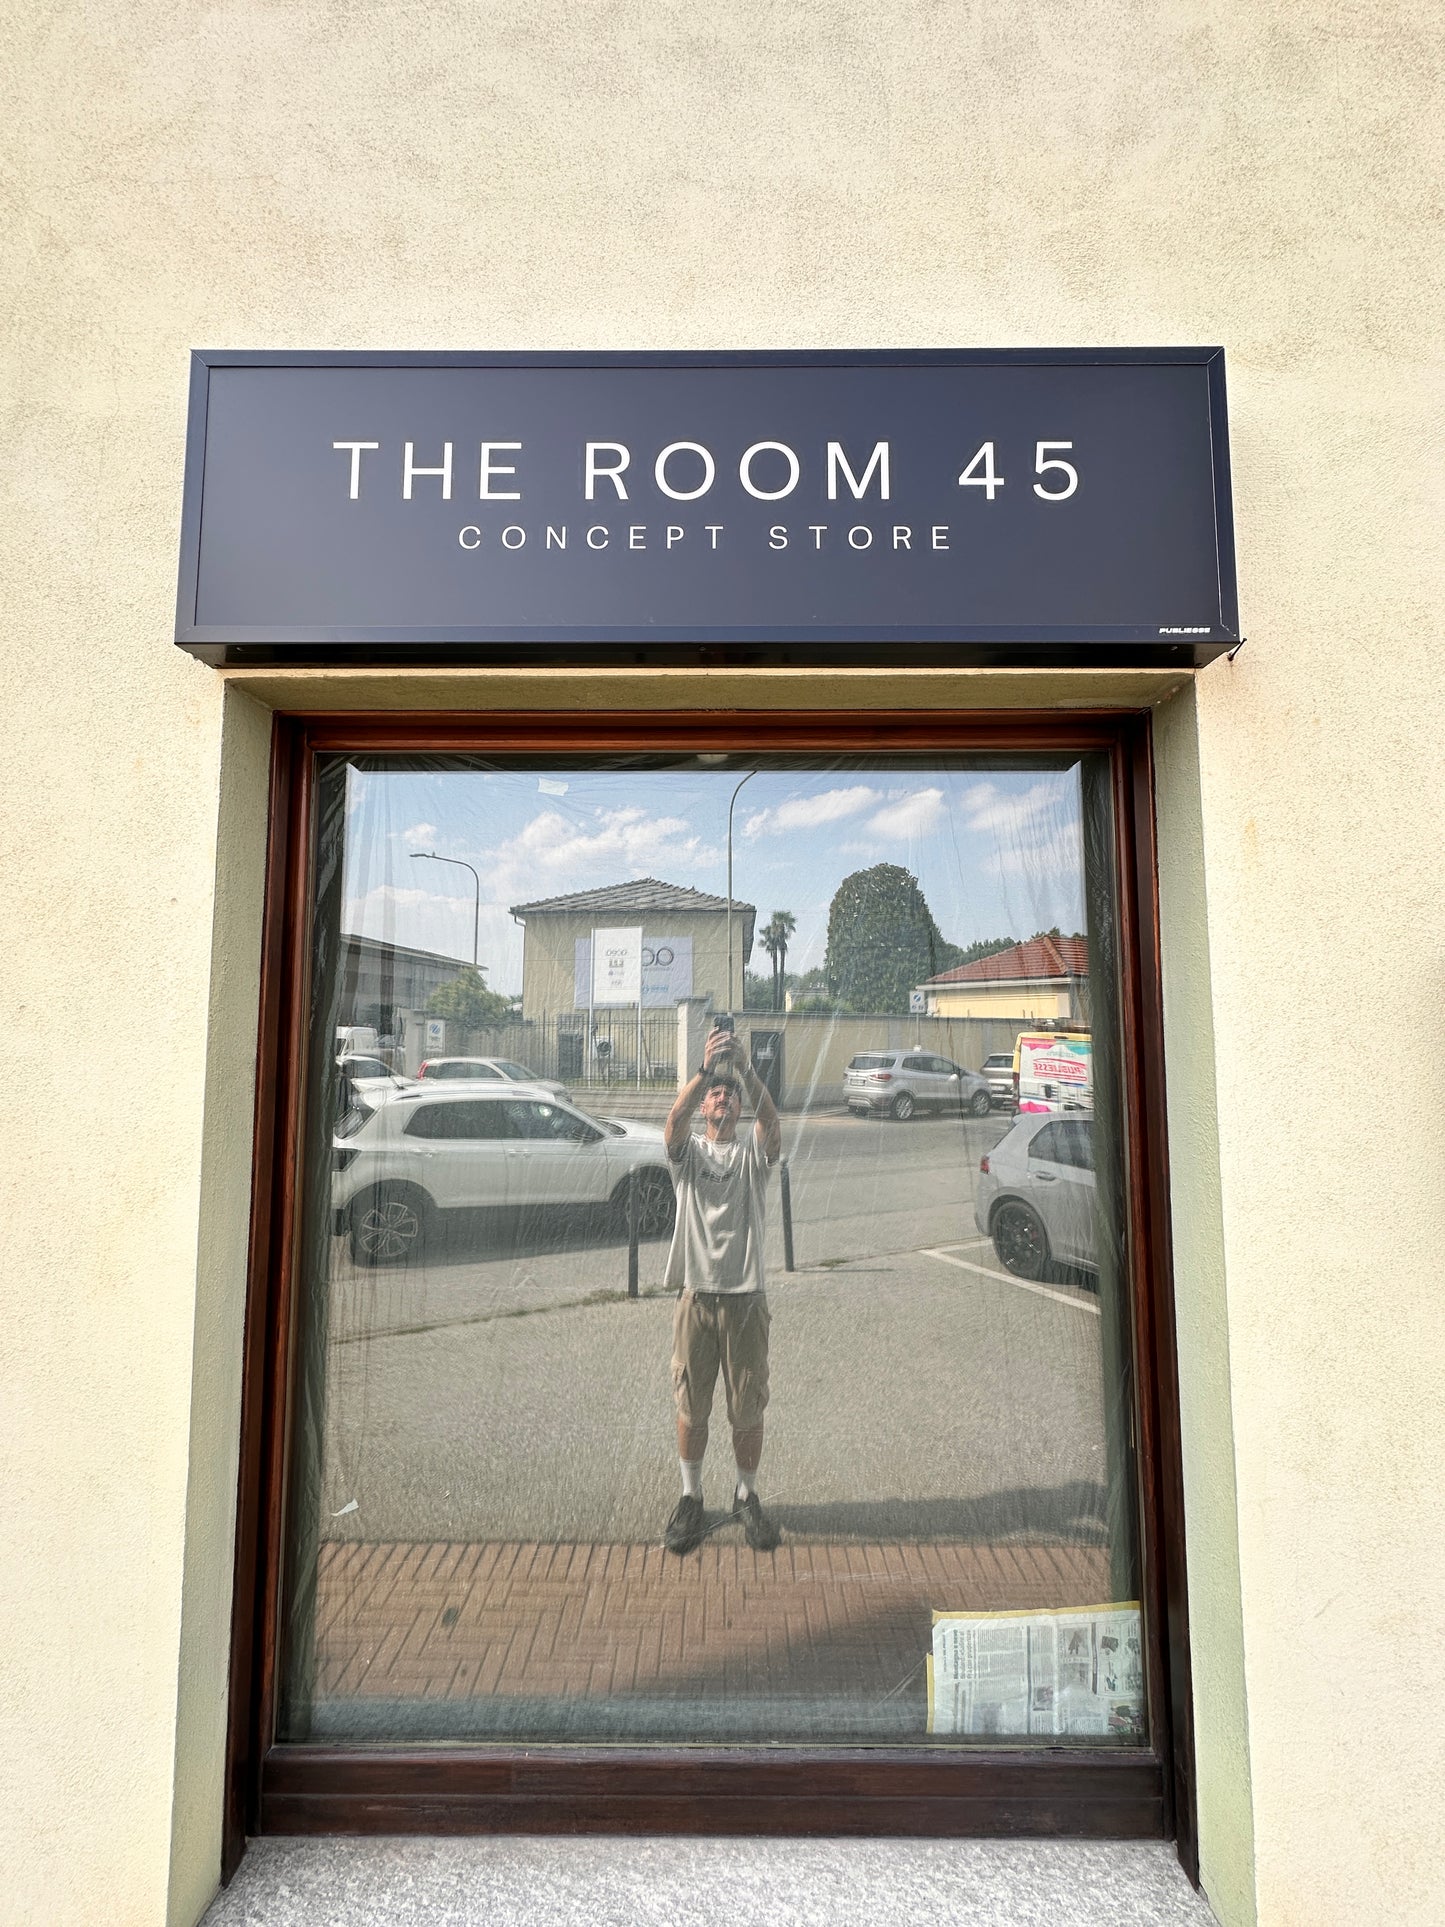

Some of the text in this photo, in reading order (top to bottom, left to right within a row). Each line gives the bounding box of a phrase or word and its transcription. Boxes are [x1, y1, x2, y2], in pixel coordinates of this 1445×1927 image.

[332, 441, 1079, 501] THE ROOM 45
[458, 525, 950, 550] CONCEPT STORE
